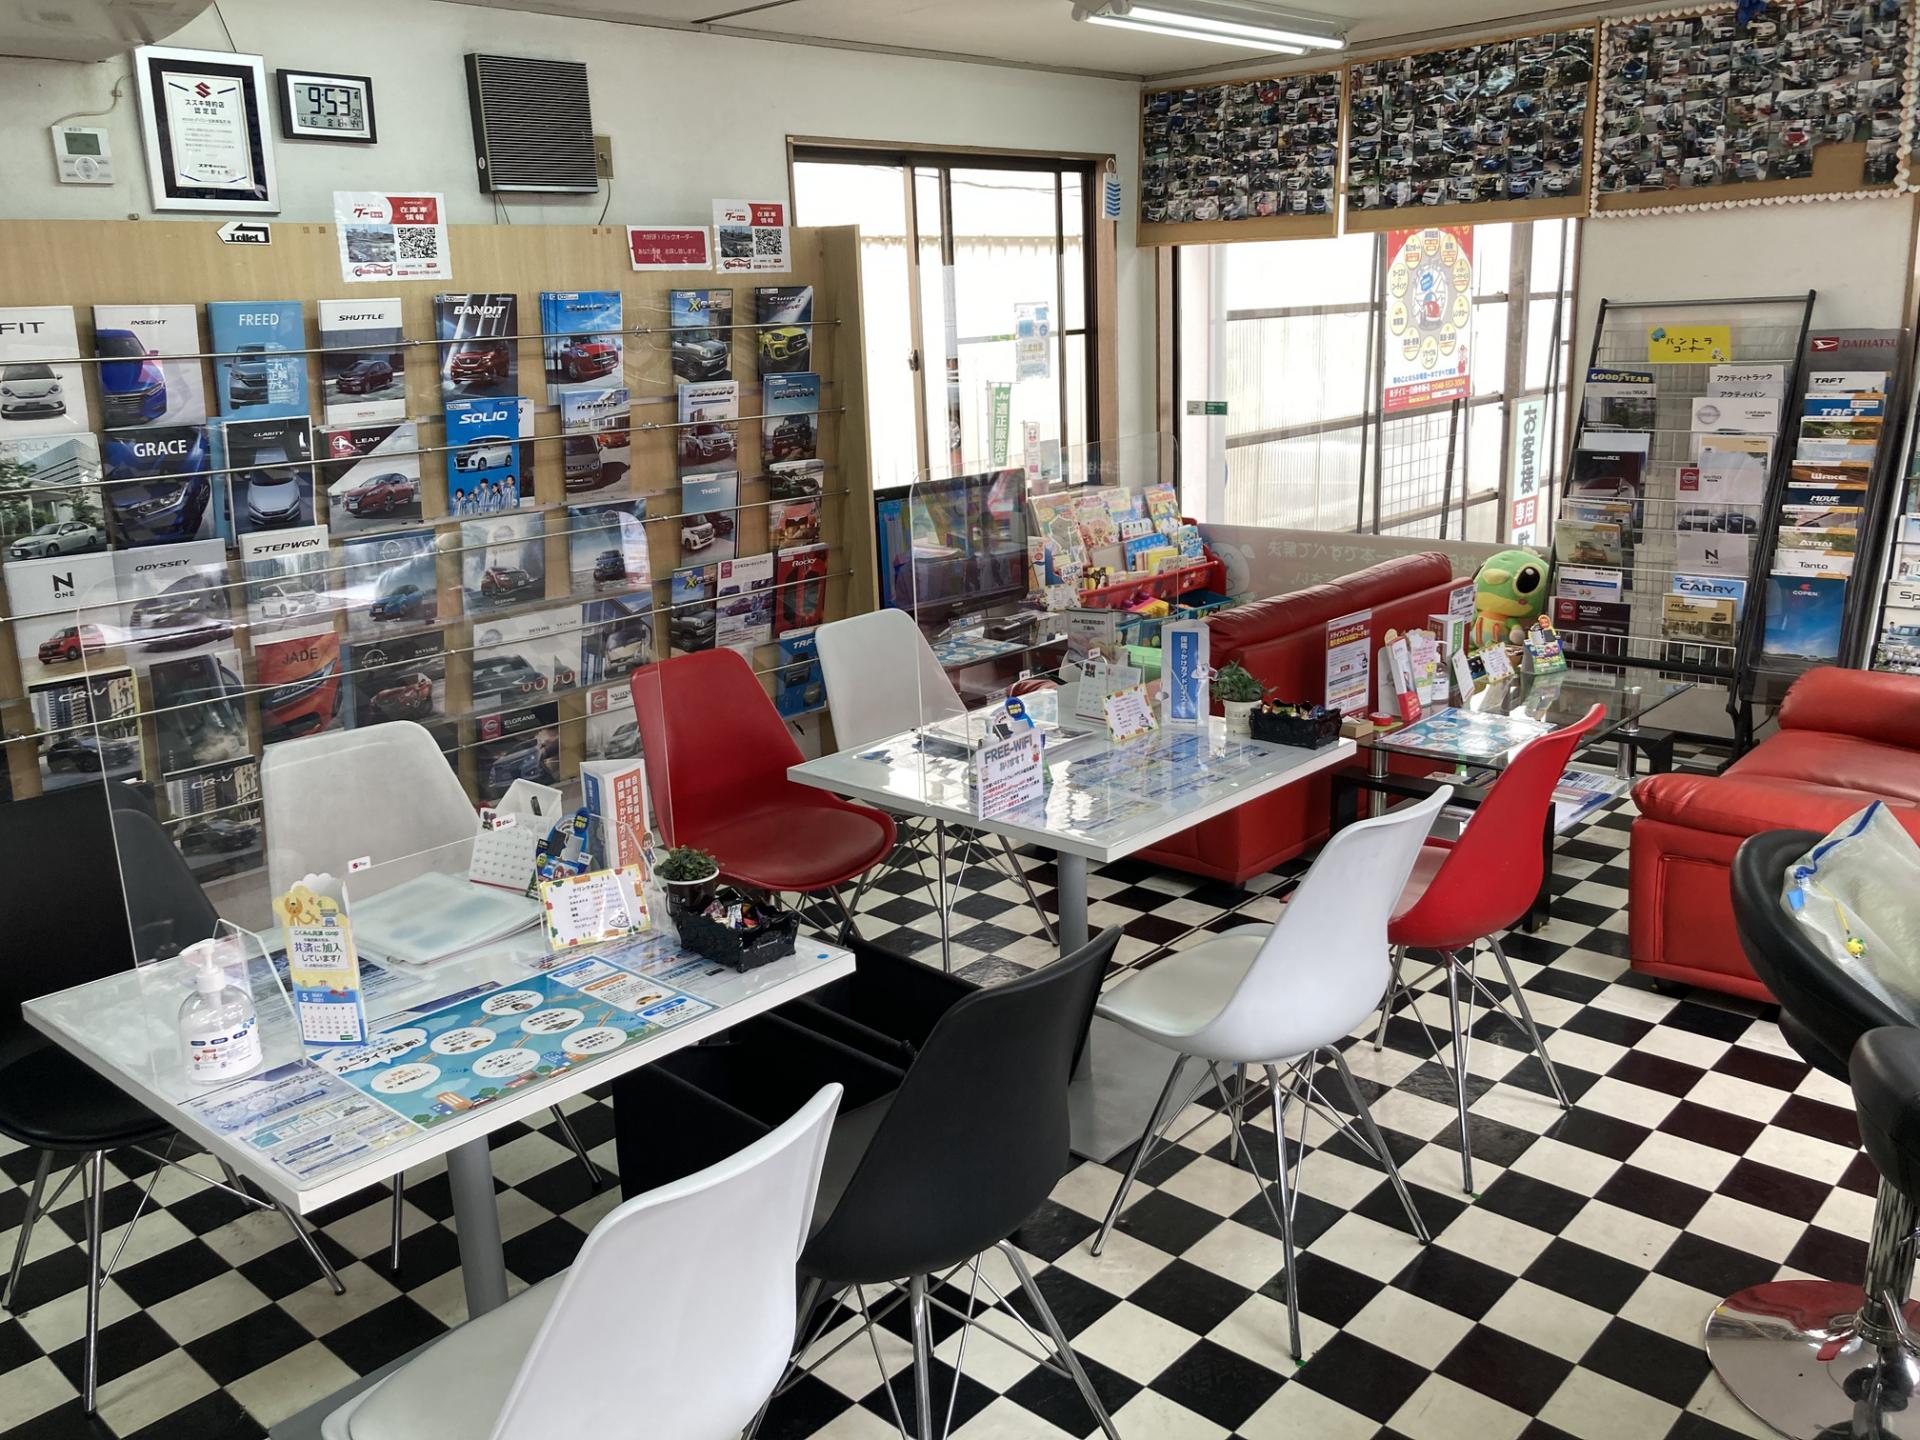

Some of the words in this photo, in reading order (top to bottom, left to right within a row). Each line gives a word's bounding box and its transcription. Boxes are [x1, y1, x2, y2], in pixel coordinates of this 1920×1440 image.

[308, 86, 351, 116] 9:53
[453, 305, 506, 315] BANDIT
[239, 313, 280, 326] FREED
[338, 313, 384, 321] SHUTTLE
[0, 321, 45, 335] FIT
[1665, 337, 1713, 345] バントラ
[1673, 345, 1704, 353] コーナー
[1590, 372, 1650, 383] GOODYEAR
[1716, 373, 1773, 382] アクティ・トラック
[458, 411, 509, 424] SOLIO
[1819, 408, 1865, 416] TAFT
[994, 402, 1009, 464] 適正販売店
[1823, 428, 1858, 436] CAST
[355, 436, 381, 444] LEAF
[133, 439, 188, 457] GRACE
[1522, 404, 1537, 495] お客様
[1811, 472, 1848, 480] WAKE
[1515, 500, 1535, 526] 専用
[253, 538, 320, 554] STEPWGN
[1799, 539, 1833, 547] ATRAI
[1705, 549, 1718, 560] N
[135, 559, 191, 572] ODYSSEY
[1799, 561, 1829, 570] Tanto
[52, 572, 74, 591] N
[1680, 582, 1735, 594] CARRY
[54, 590, 75, 599] ONE
[282, 647, 320, 665] JADE
[58, 686, 108, 702] CR-V
[504, 713, 536, 726] ELGRAND
[191, 773, 234, 789] CR-V
[294, 942, 342, 953] 共済に加入
[302, 993, 309, 1002] 5
